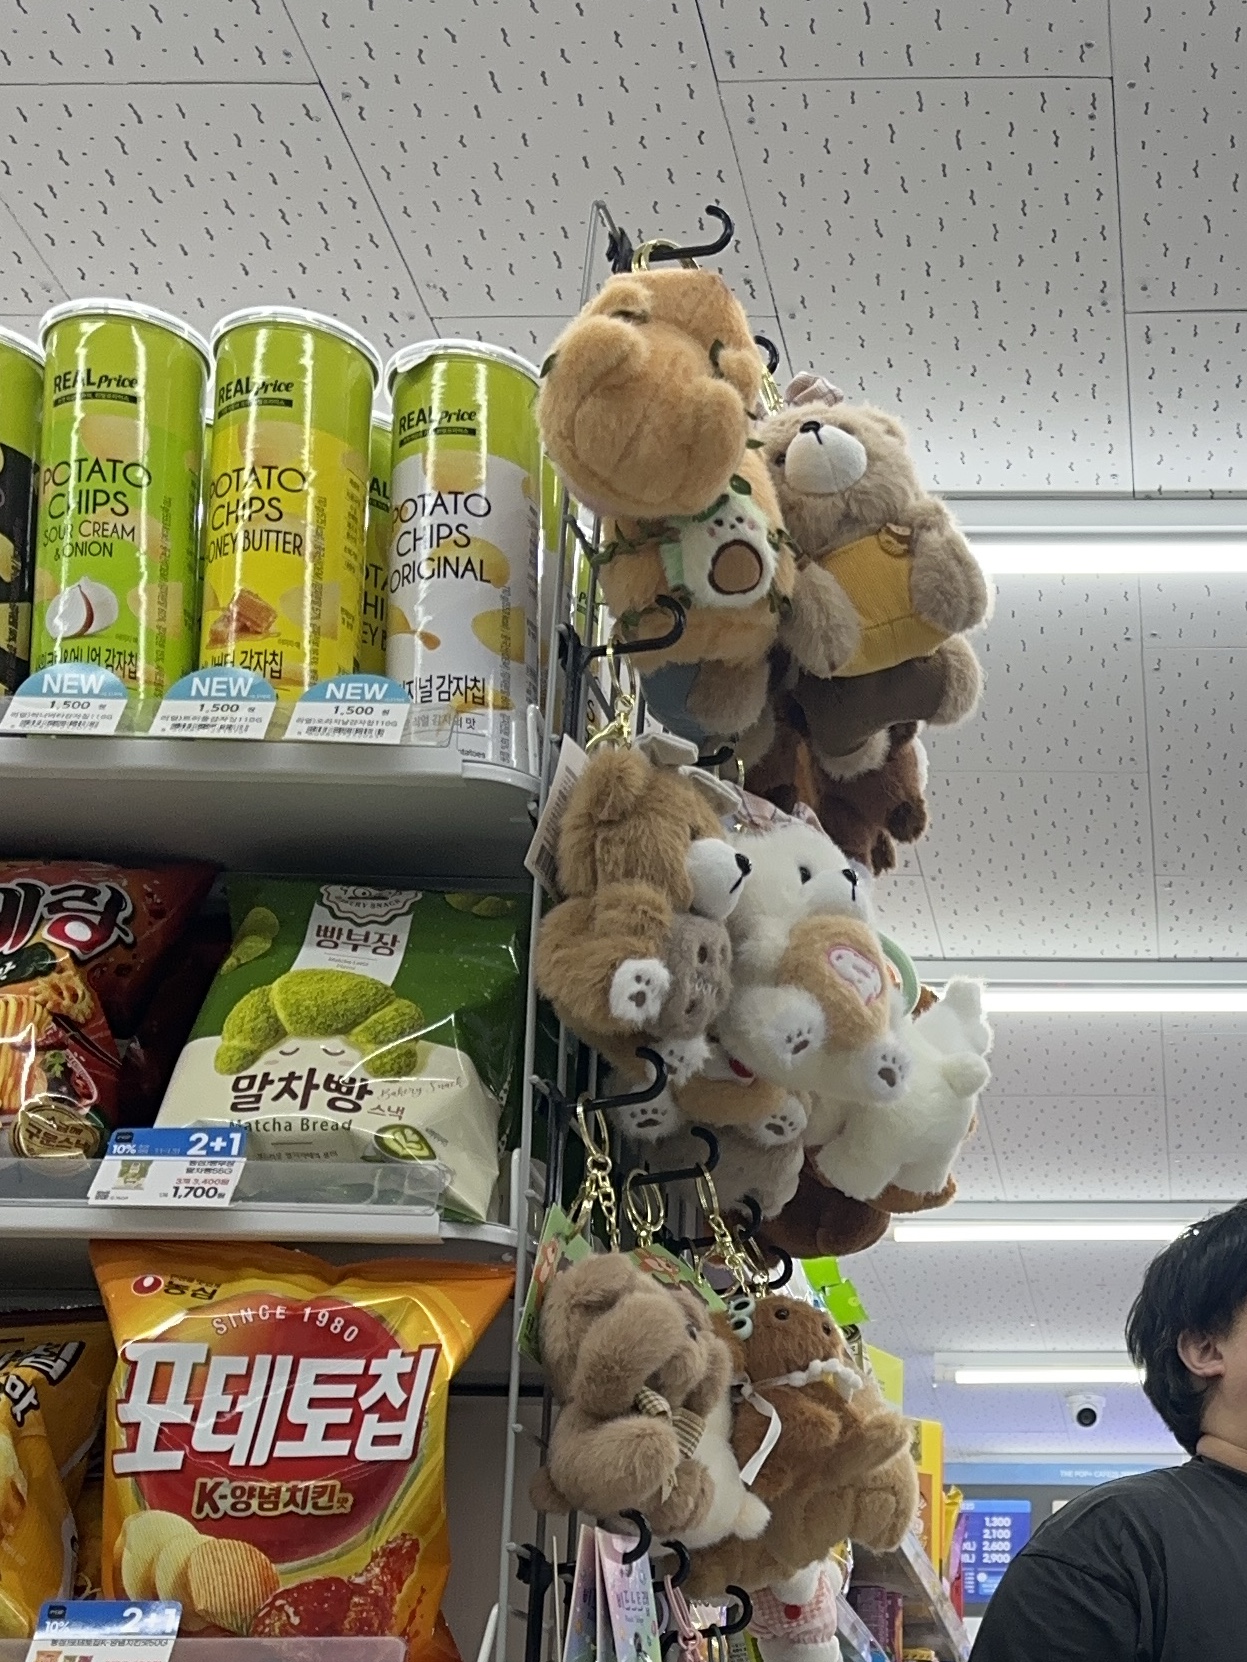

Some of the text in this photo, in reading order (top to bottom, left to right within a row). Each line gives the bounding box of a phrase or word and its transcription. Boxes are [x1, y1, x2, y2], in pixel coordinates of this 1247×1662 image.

[53, 368, 139, 393] REAL Price
[218, 376, 294, 400] REAL Price
[398, 409, 477, 434] REAL Price
[43, 456, 153, 492] POTATO
[208, 465, 308, 500] POTATO
[48, 491, 130, 518] CHIPS
[211, 497, 285, 531] CHIPS
[391, 490, 493, 525] POTATO
[43, 520, 137, 549] SOUR CREAM
[205, 529, 305, 565] ONEY BUTTER
[396, 523, 472, 556] CHIPS
[62, 541, 115, 560] ONION
[390, 557, 492, 597] ORIGINAL
[42, 673, 105, 695] NEW
[190, 677, 254, 698] NEW
[325, 682, 388, 701] NEW
[436, 674, 487, 707] 감자칩
[48, 700, 91, 710] 1,500
[198, 703, 240, 713] 1,500
[333, 706, 374, 716] 1,500
[315, 924, 401, 957] 빵부장
[229, 1066, 374, 1114] 말차빵
[229, 1117, 353, 1133] Matcha Bread
[366, 1103, 407, 1122] 스낵
[112, 1132, 243, 1156] 10% 2+1
[211, 1304, 360, 1343] SINCE 1980
[111, 1342, 437, 1476] 포테토칩
[44, 1606, 178, 1634] 10% 2+1
